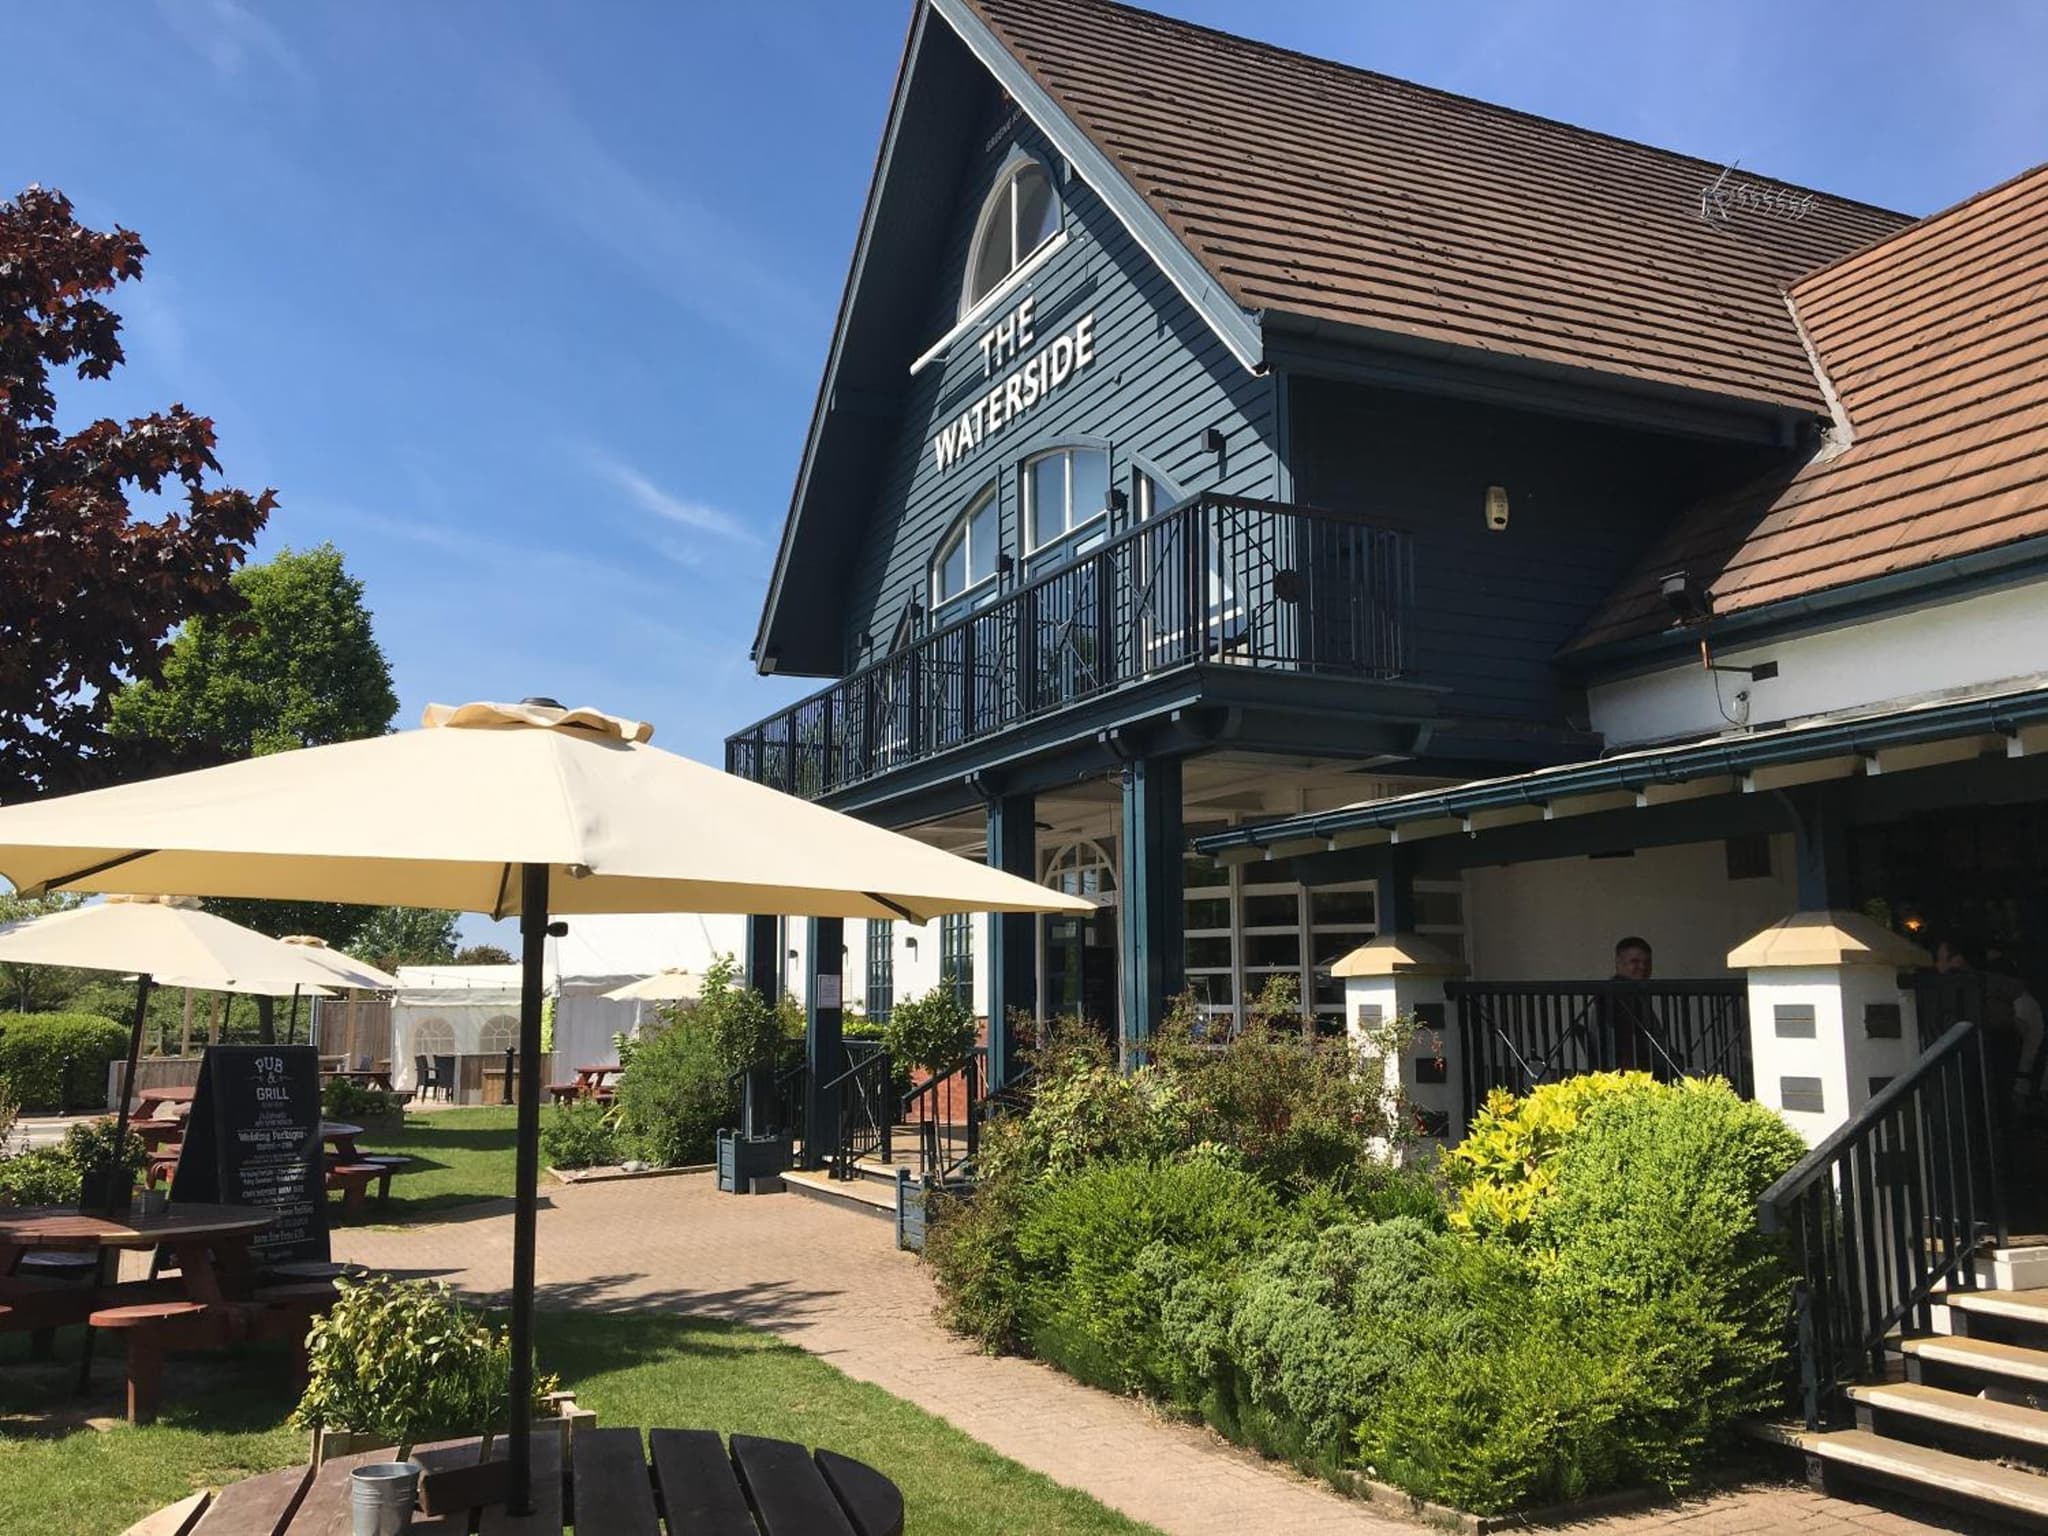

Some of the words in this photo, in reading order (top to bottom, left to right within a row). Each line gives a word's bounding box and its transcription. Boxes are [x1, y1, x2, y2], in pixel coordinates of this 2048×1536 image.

[979, 296, 1034, 377] THE
[935, 313, 1094, 472] WATERSIDE
[255, 1056, 283, 1073] PUB
[256, 1087, 289, 1101] GRILL
